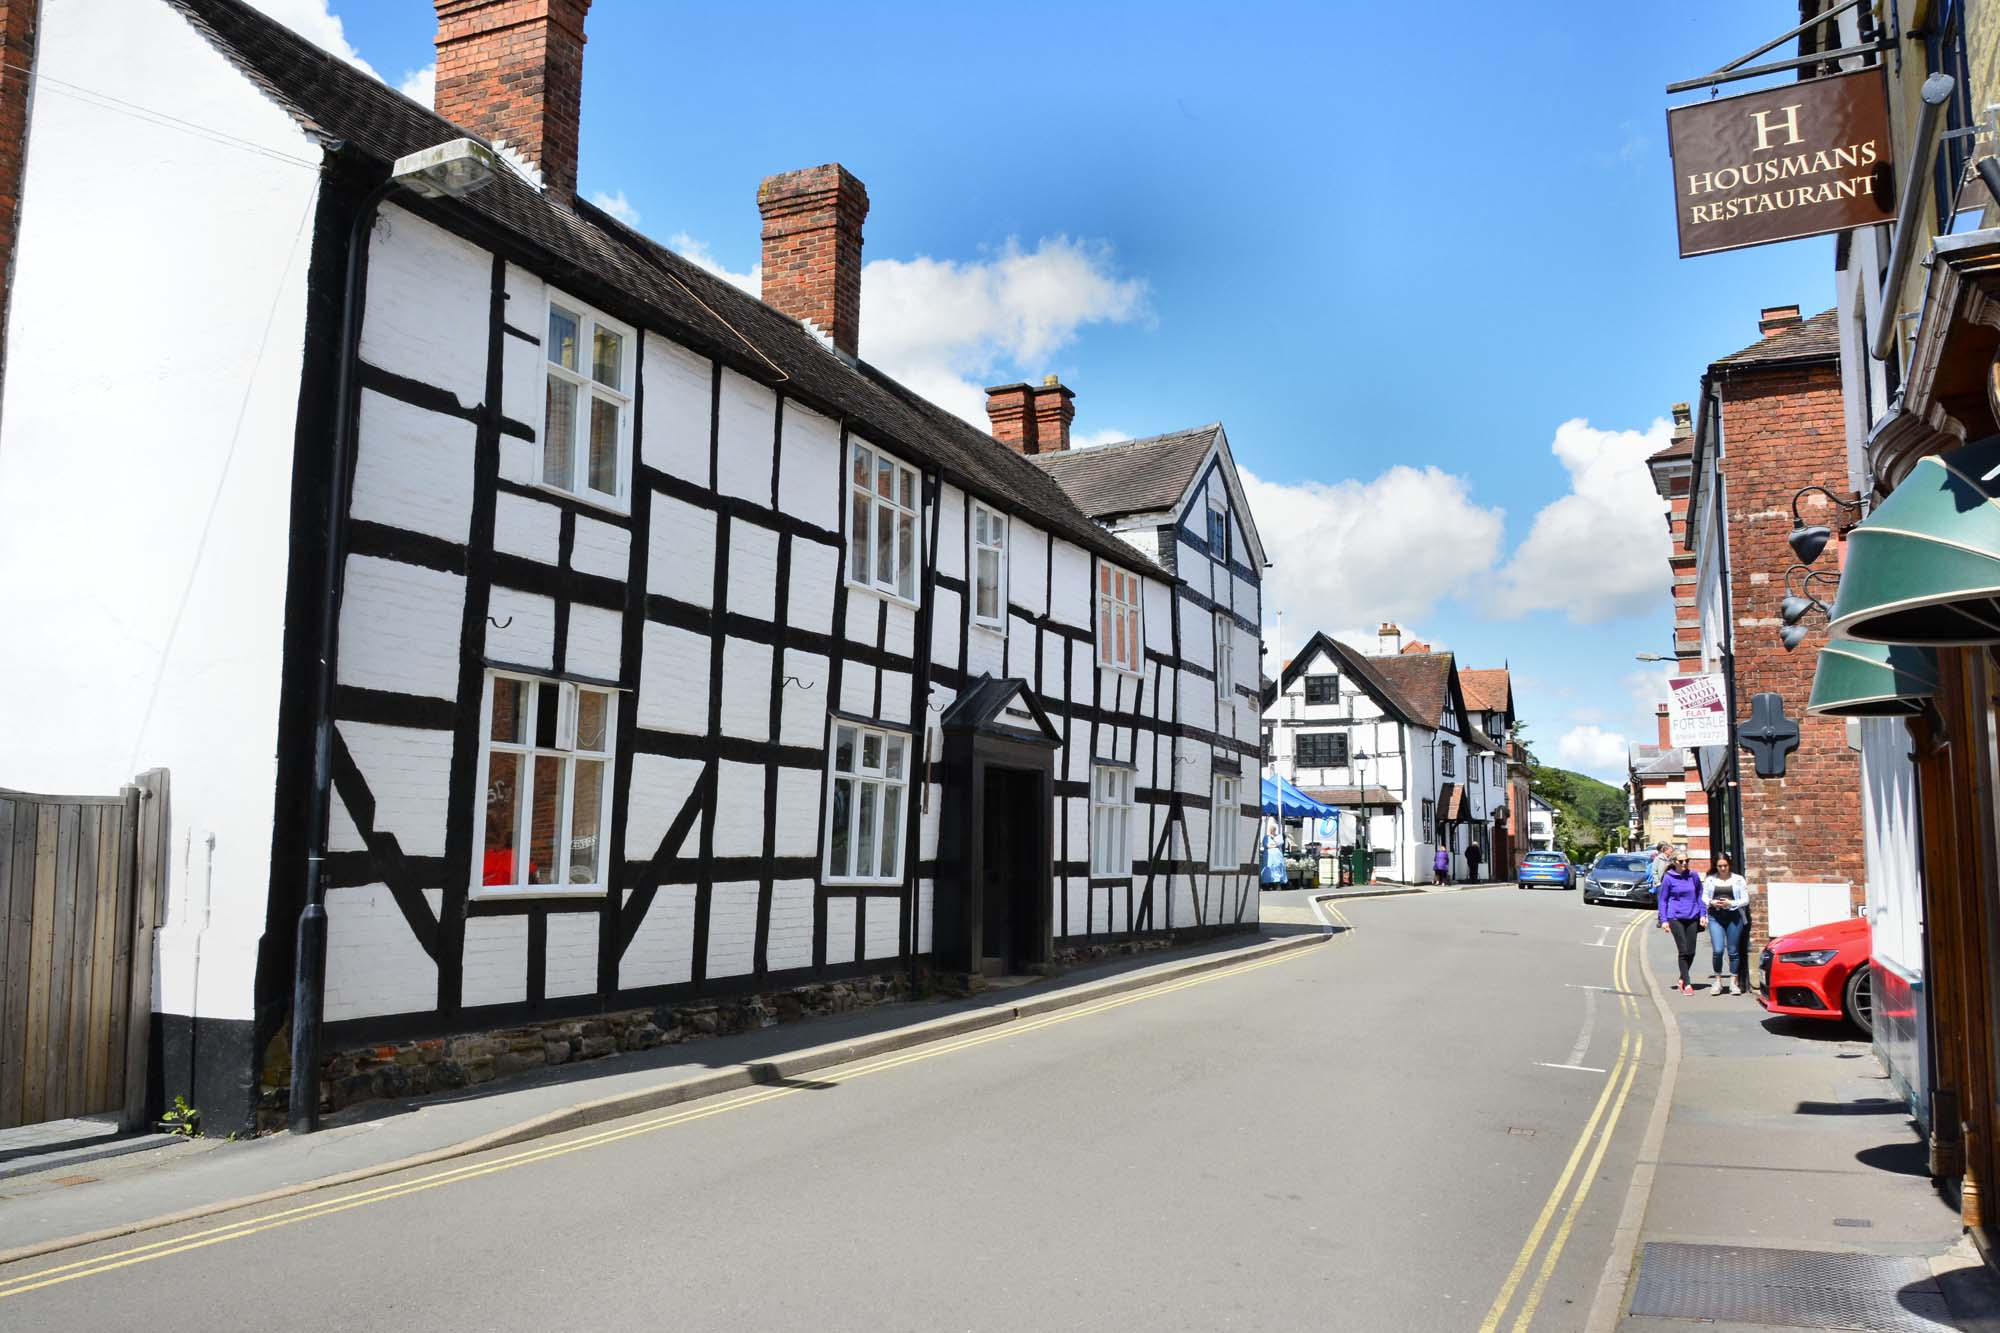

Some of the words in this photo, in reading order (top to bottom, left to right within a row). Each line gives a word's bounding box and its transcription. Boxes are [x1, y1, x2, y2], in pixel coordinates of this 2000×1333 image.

[1750, 104, 1805, 153] H
[1687, 139, 1877, 196] HOUSMANS
[1691, 174, 1878, 225] RESTAURANT
[1675, 679, 1713, 697] SAMUEL
[1677, 686, 1716, 705] WOOD
[1673, 718, 1695, 730] FOR
[1699, 715, 1726, 729] SALE
[1686, 709, 1707, 717] FLAT
